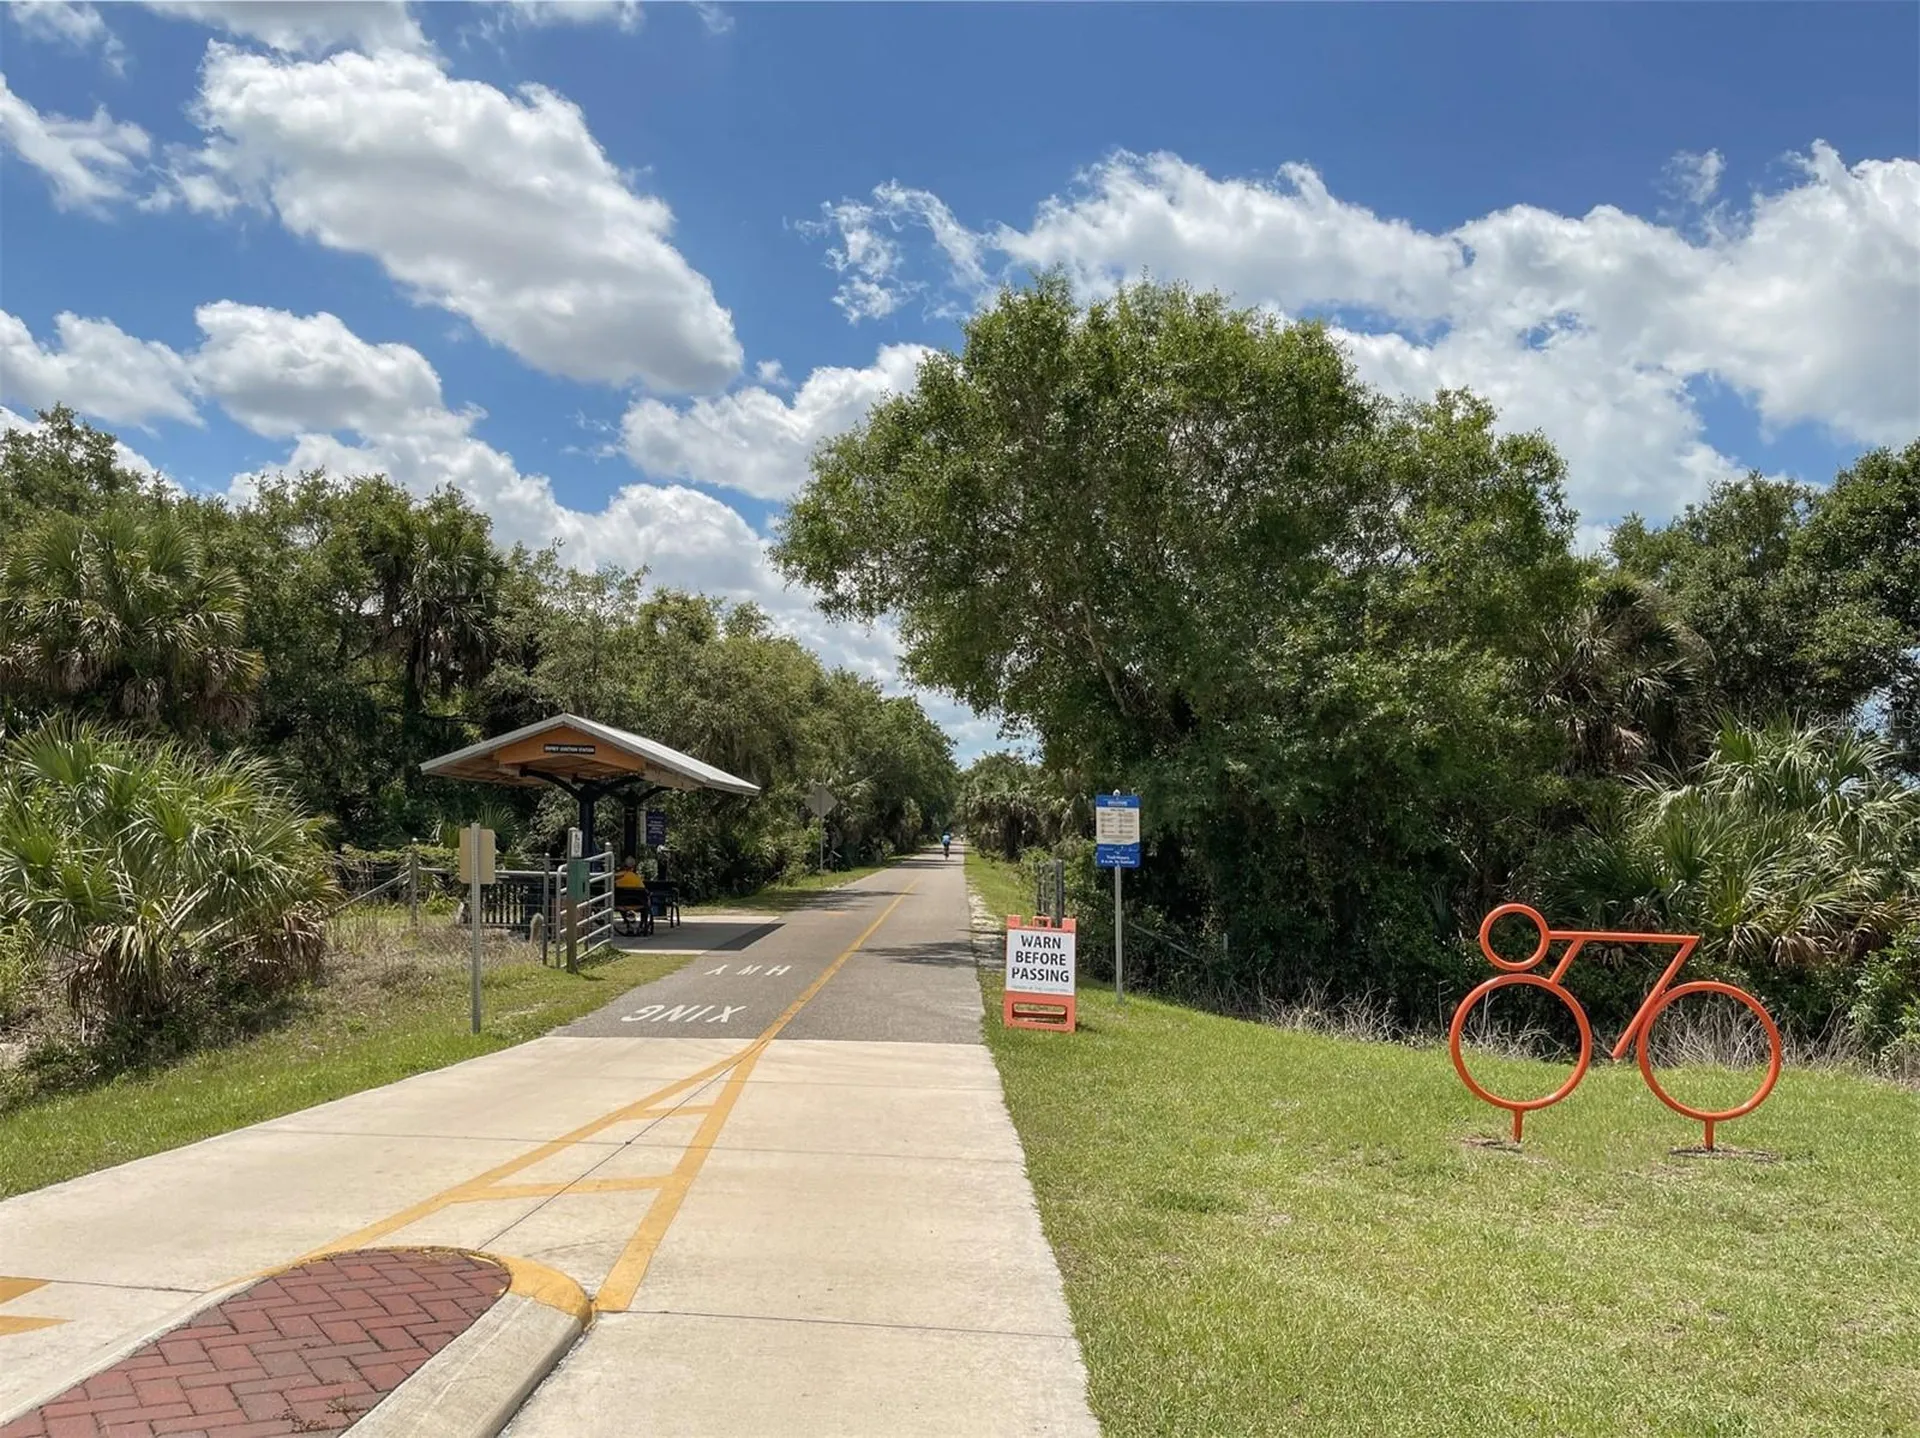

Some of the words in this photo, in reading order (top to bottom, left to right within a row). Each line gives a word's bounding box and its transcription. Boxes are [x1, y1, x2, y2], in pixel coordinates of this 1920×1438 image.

[1021, 935, 1061, 949] WARN
[1016, 951, 1066, 966] BEFORE
[703, 964, 793, 976] HWY
[1012, 967, 1069, 983] PASSING
[621, 1004, 747, 1023] XING
